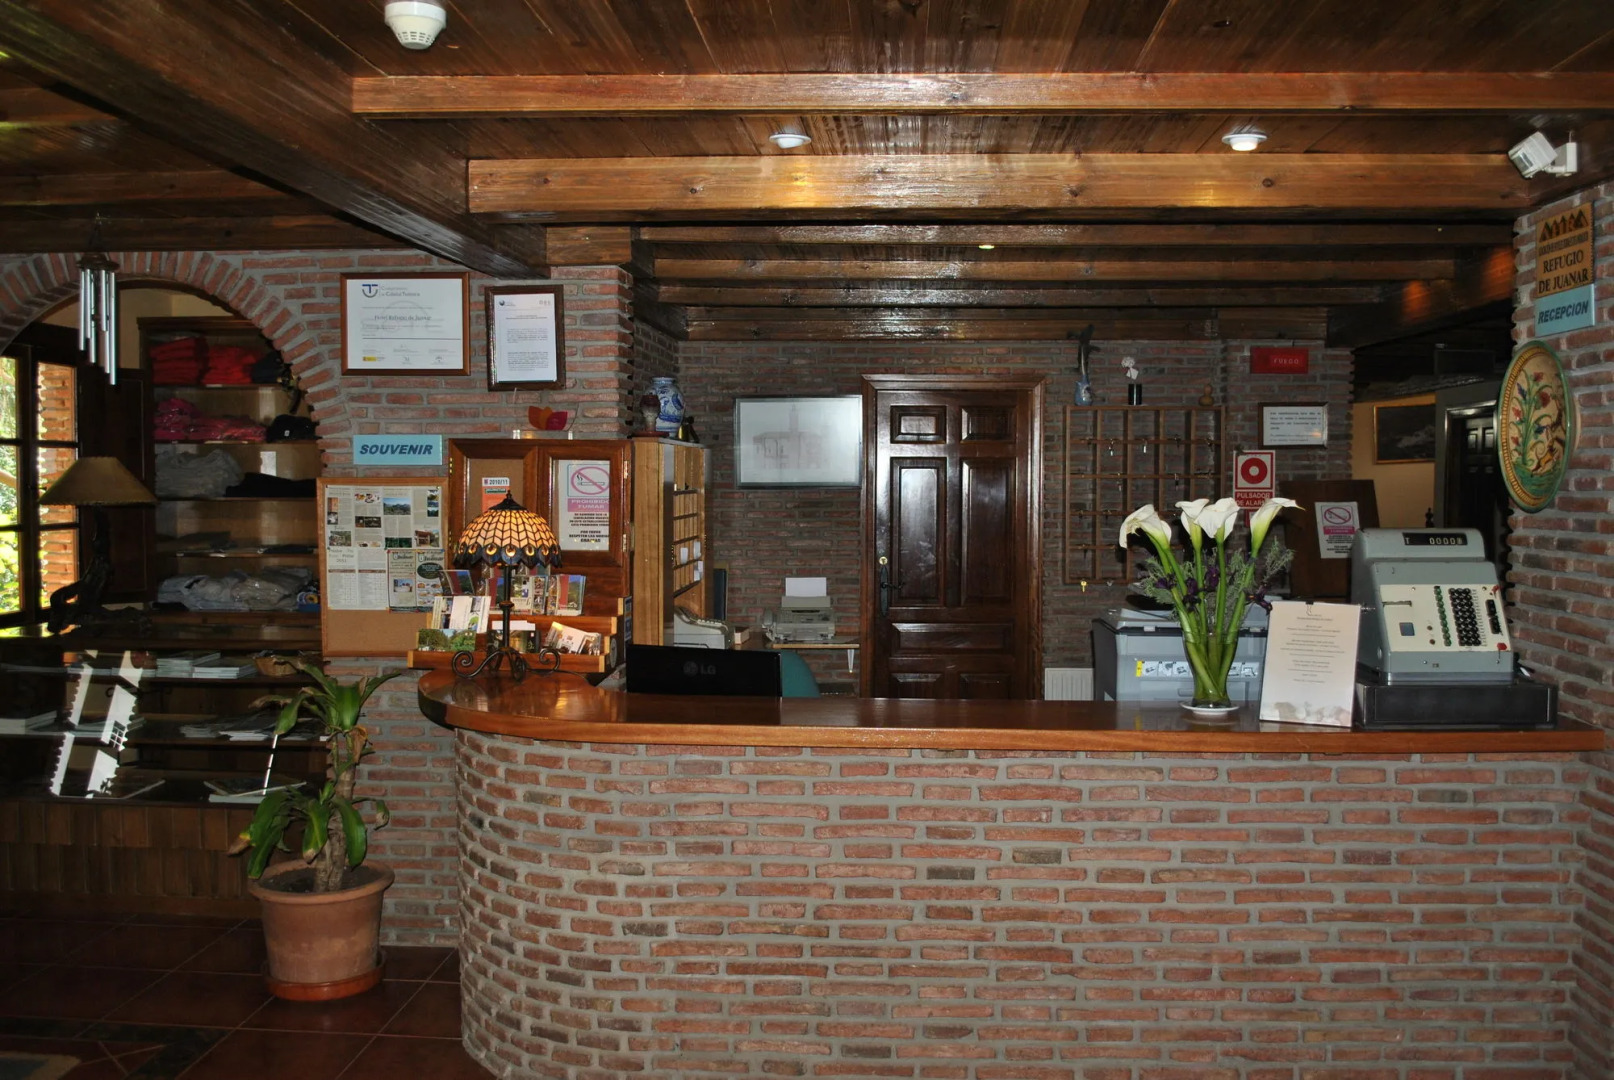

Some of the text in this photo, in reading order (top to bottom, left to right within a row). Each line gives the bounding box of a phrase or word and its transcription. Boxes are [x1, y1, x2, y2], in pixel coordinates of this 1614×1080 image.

[1543, 249, 1584, 274] REFUGIO
[1538, 268, 1589, 294] DE JUANAR
[1537, 300, 1590, 325] RECEPCION
[359, 444, 434, 455] SOUVENIR
[700, 663, 716, 675] LG
